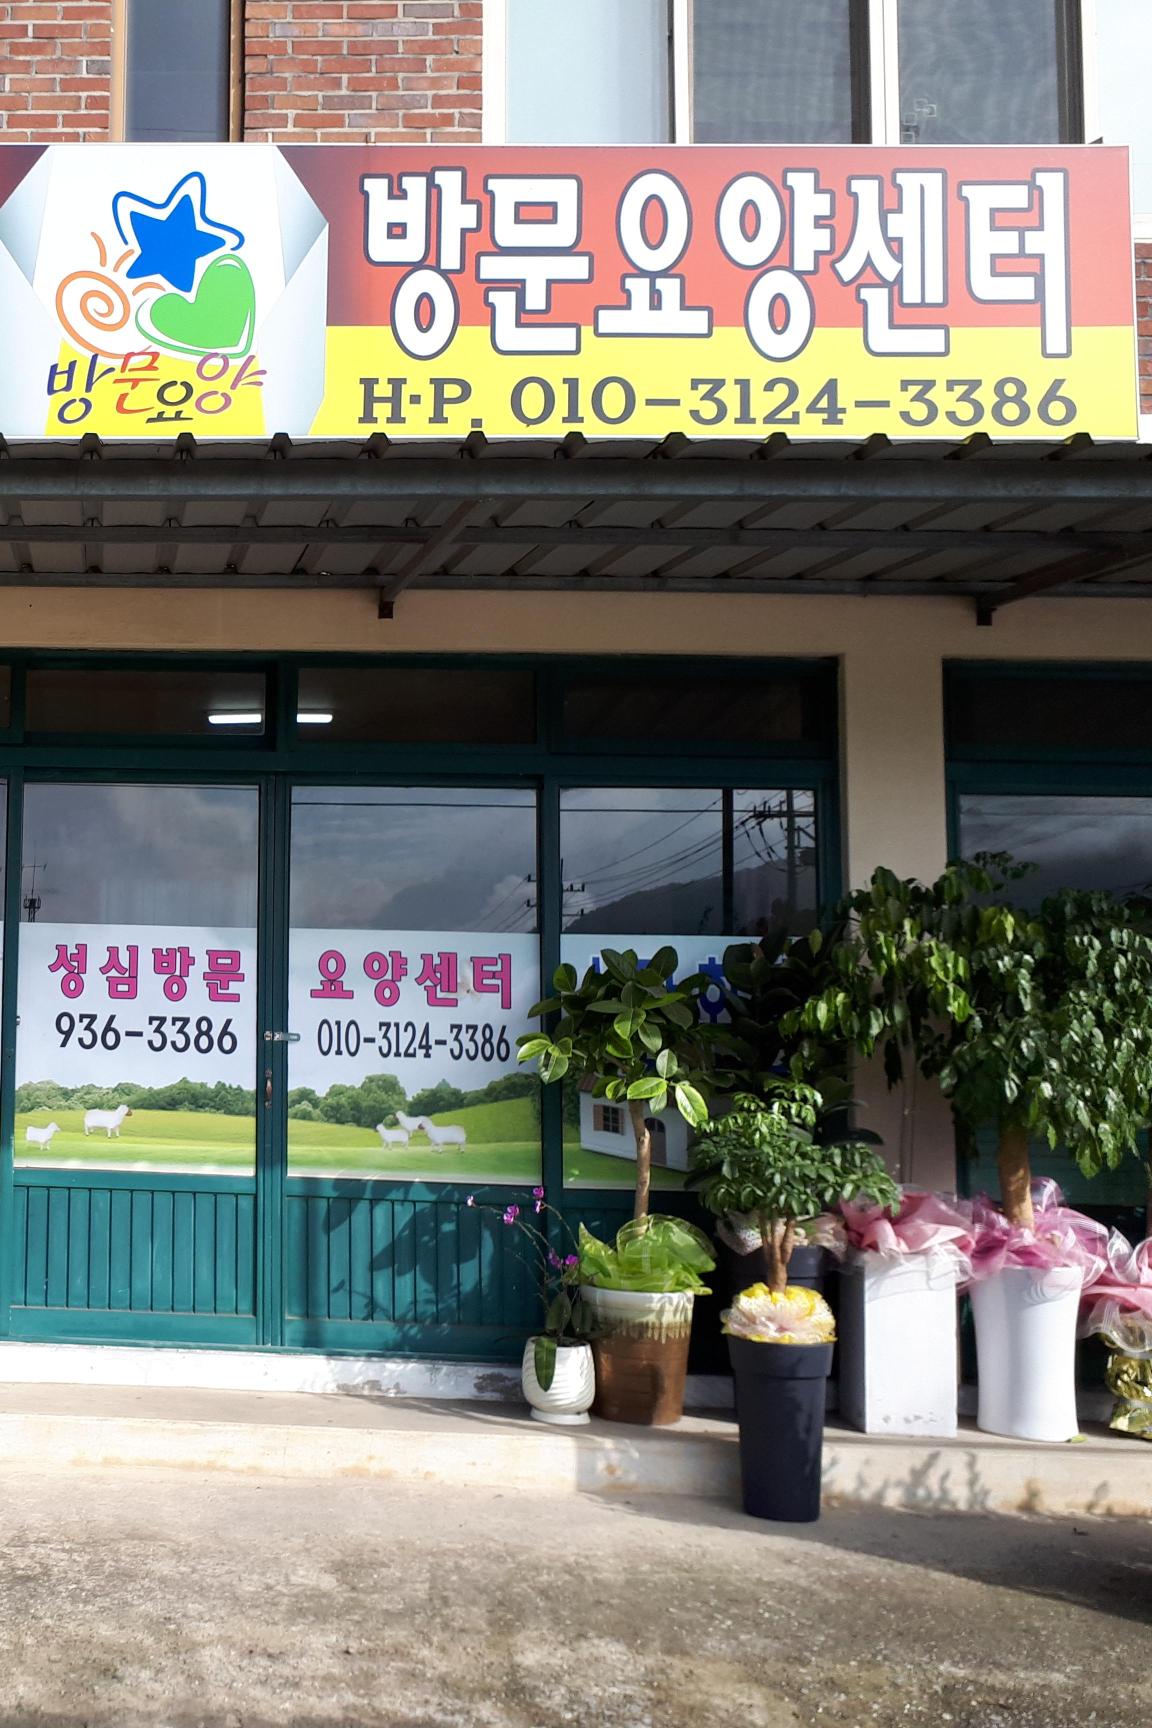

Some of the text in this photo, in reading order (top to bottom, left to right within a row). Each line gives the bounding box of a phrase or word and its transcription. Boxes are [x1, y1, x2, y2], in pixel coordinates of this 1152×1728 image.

[359, 165, 1072, 362] 방문요양센터
[47, 352, 267, 424] 방문요양
[510, 376, 1078, 429] 010-3124-3386
[48, 943, 512, 1009] 성심방문 요양센터
[54, 1011, 511, 1062] 936-3386 010-3124-3386
